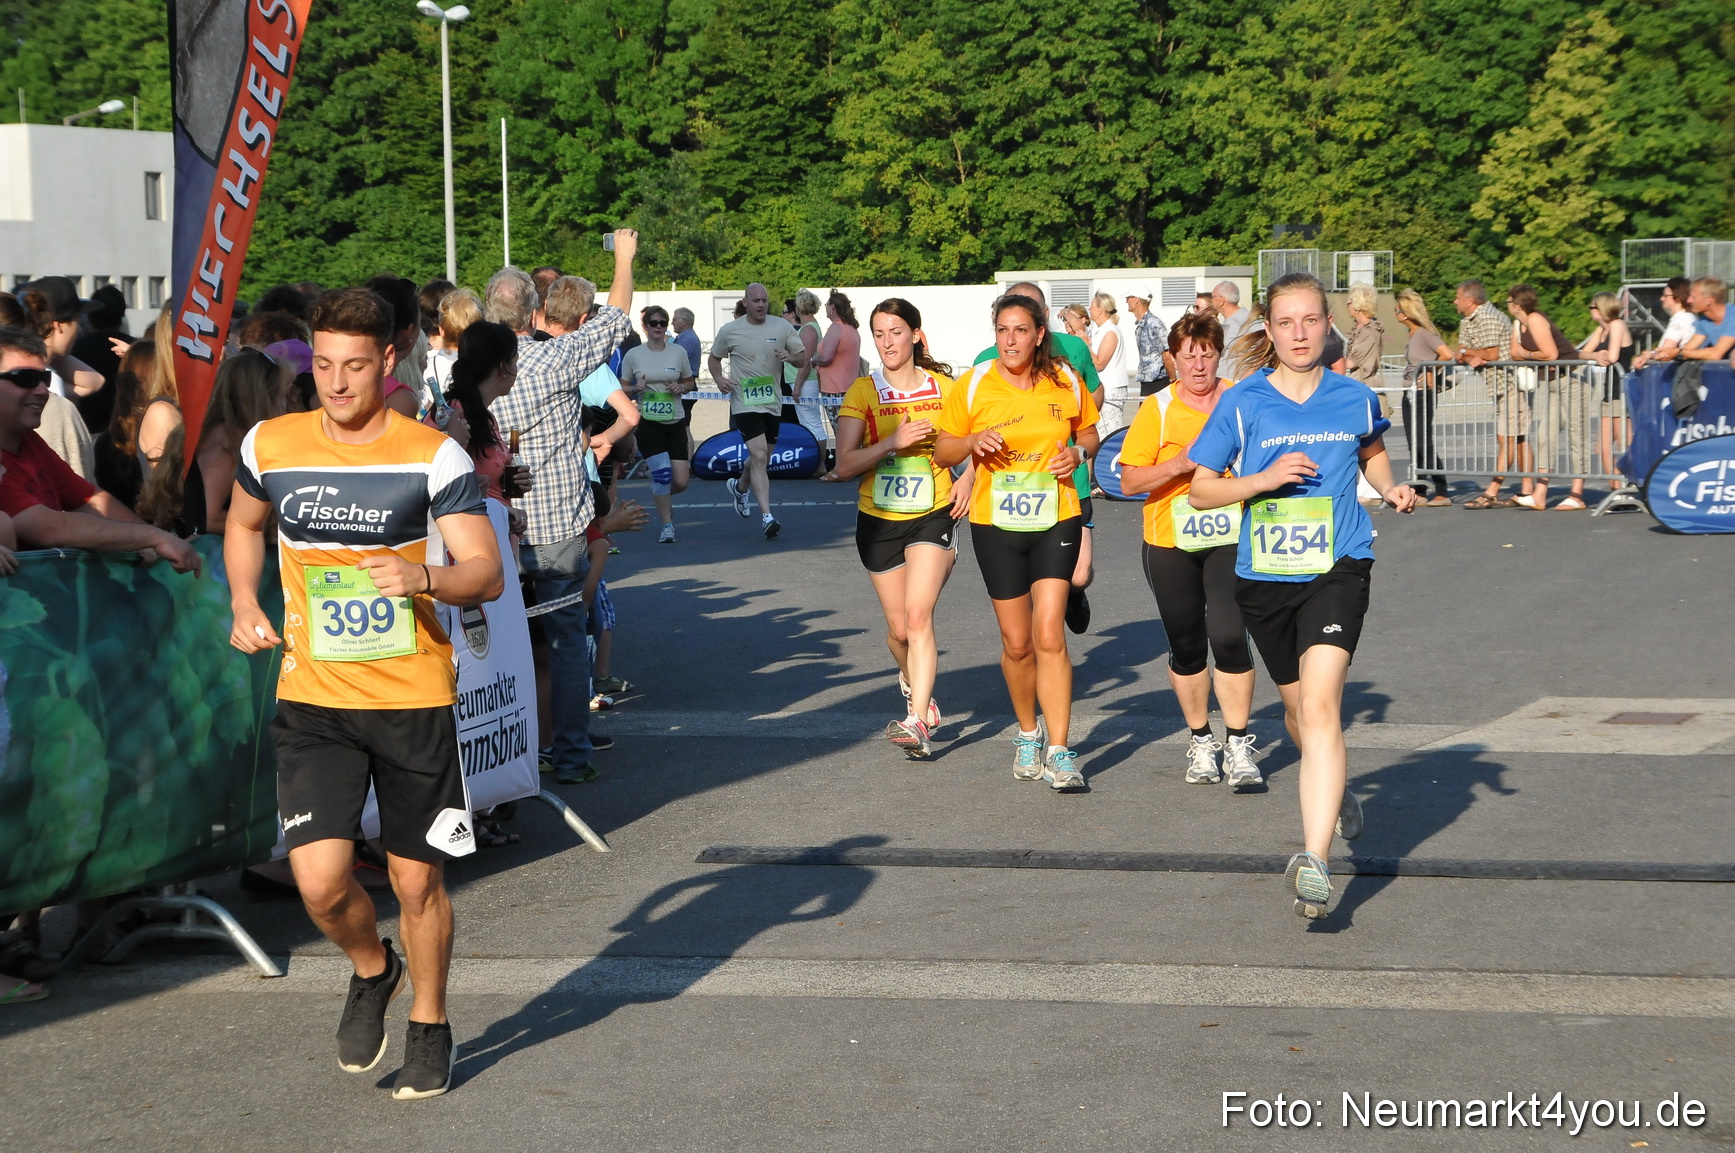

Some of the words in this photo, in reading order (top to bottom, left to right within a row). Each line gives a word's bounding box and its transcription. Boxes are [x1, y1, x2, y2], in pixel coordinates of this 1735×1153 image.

[743, 385, 773, 399] 1419
[643, 402, 673, 414] 1423
[879, 406, 910, 417] MAX
[1260, 431, 1356, 449] energiegeladen
[1671, 415, 1735, 446] Fisch
[727, 447, 803, 471] Fiher
[881, 476, 924, 498] 787
[297, 501, 392, 523] Fischer
[999, 493, 1047, 516] 467
[307, 521, 385, 533] AUTOMOBILE
[1182, 513, 1231, 537] 469
[1253, 524, 1329, 555] 1254
[319, 581, 355, 589] firmenlauf
[321, 597, 395, 637] 399
[458, 672, 517, 722] eumarkter
[461, 709, 528, 777] mmsbräu
[448, 831, 471, 844] adidas
